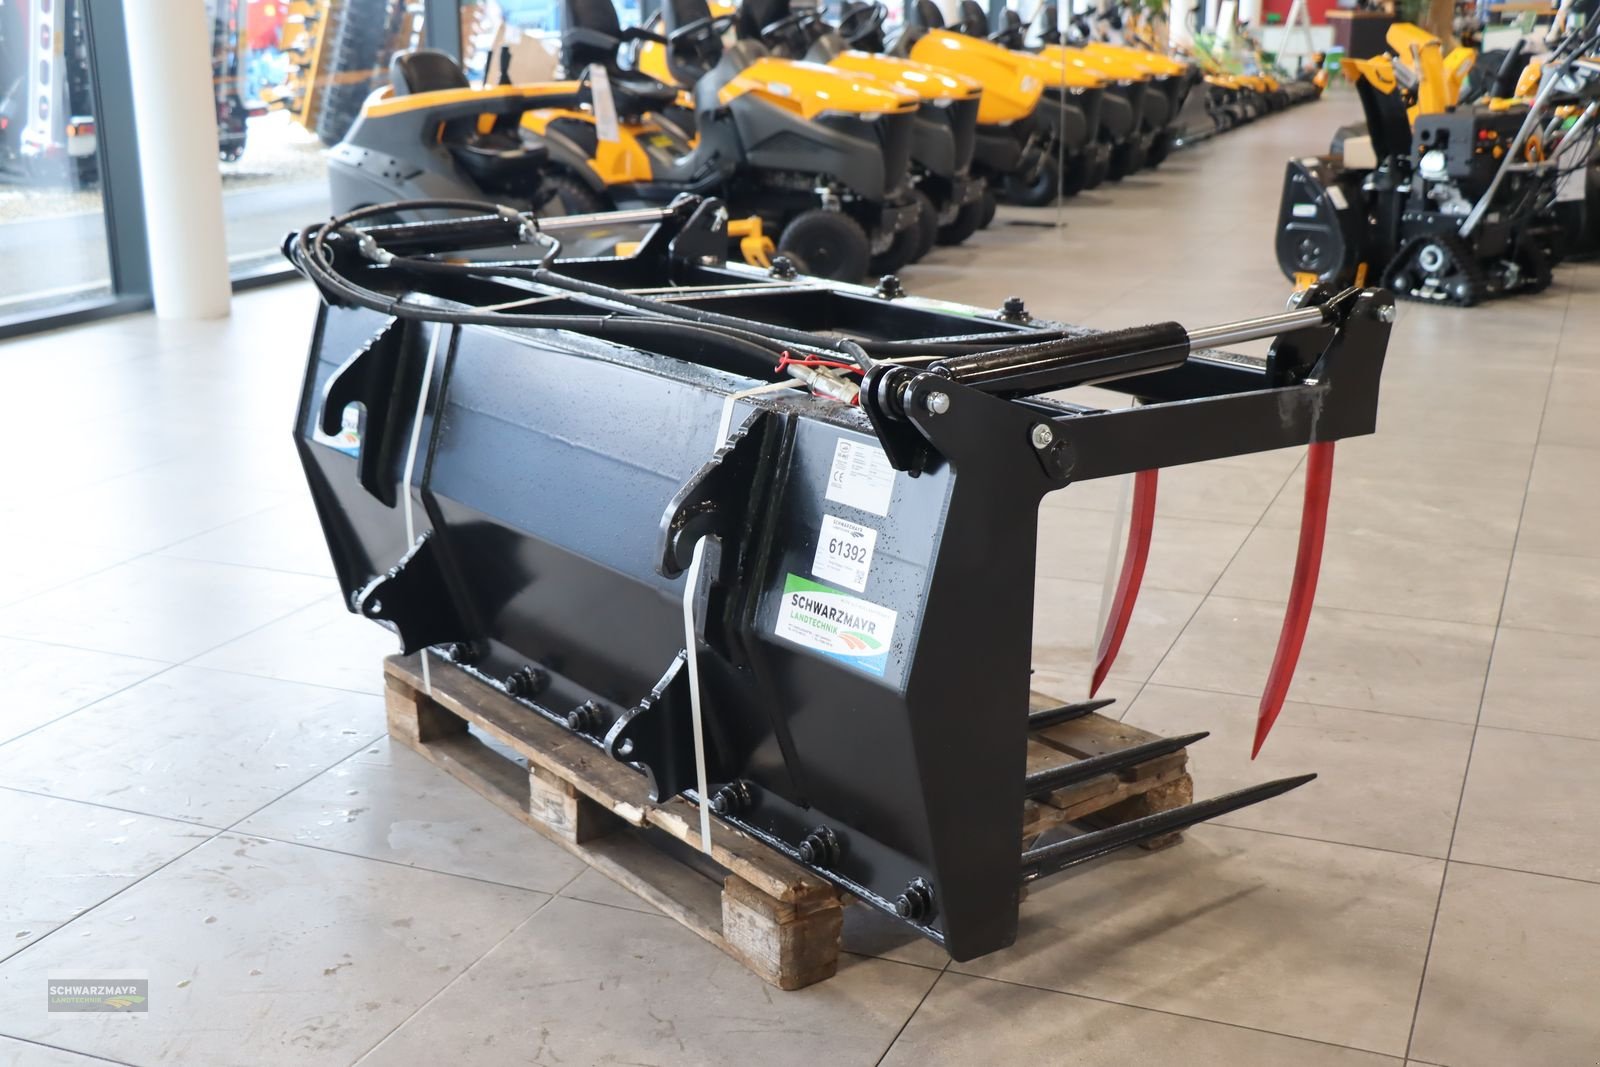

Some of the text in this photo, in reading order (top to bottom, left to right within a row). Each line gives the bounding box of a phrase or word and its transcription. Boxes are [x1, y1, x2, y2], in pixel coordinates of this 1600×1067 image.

[833, 519, 863, 533] SCHWARZMAYR
[829, 538, 867, 564] 61392
[790, 610, 838, 636] LANDTECHNIK
[791, 593, 876, 635] SCHWARZMAYR
